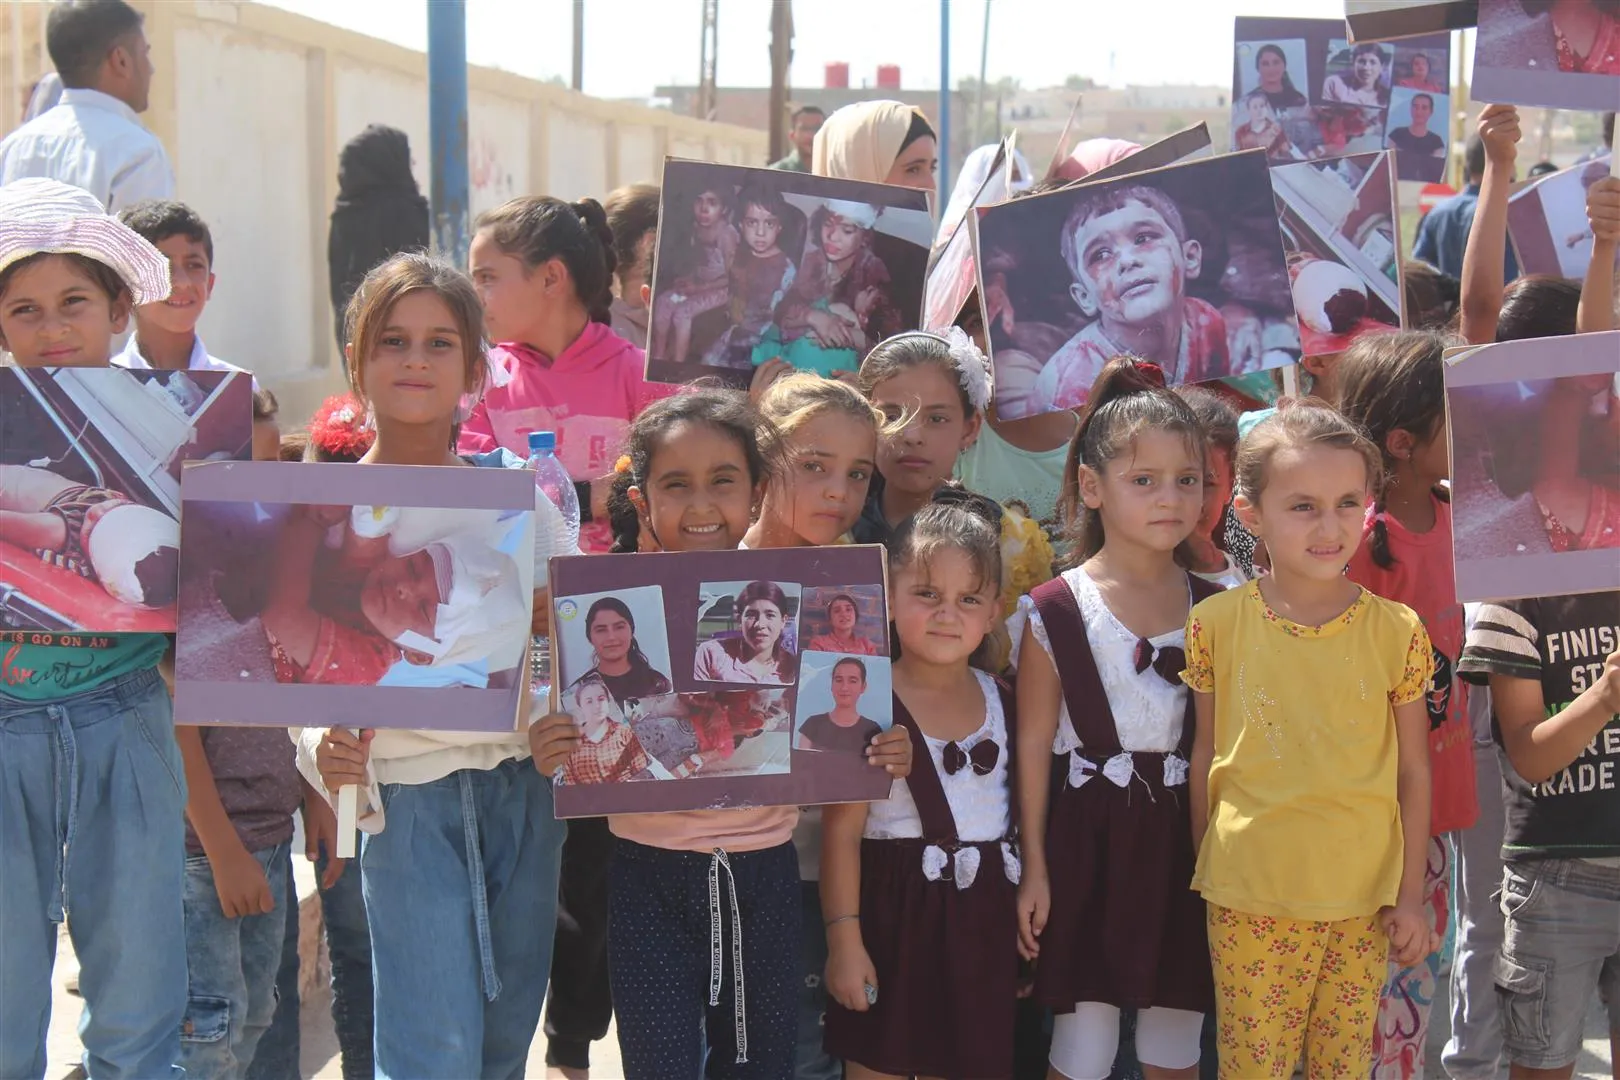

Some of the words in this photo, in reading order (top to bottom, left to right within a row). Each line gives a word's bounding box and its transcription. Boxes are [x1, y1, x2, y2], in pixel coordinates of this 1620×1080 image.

[31, 633, 53, 646] GO
[60, 635, 82, 647] ON
[1571, 662, 1607, 694] ST
[1531, 761, 1615, 798] RADE
